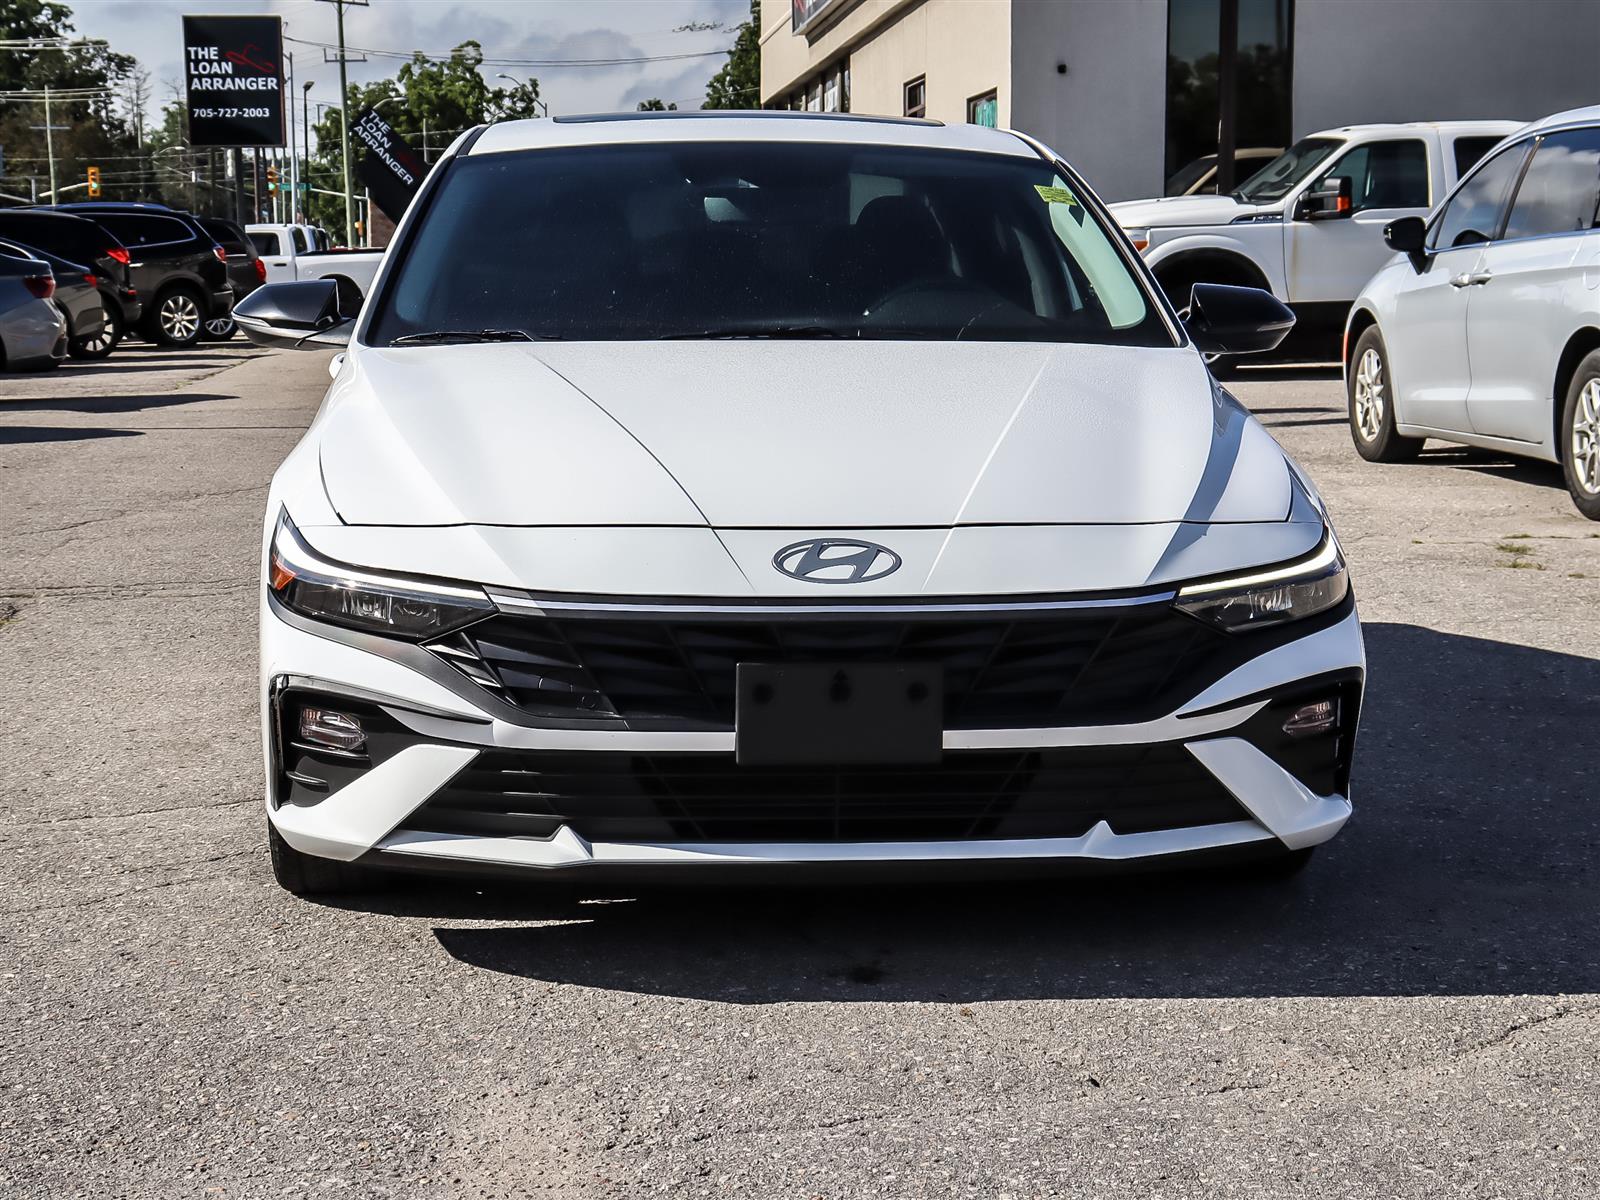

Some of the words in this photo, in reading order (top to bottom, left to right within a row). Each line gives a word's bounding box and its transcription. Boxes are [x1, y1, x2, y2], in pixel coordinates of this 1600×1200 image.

[187, 46, 219, 60] THE
[189, 61, 233, 75] LOAN
[190, 77, 279, 91] ARRANGER
[193, 107, 270, 118] 705-727-2003
[368, 110, 392, 135] THE
[360, 116, 393, 149] LOAN
[353, 125, 414, 186] ARRANGER
